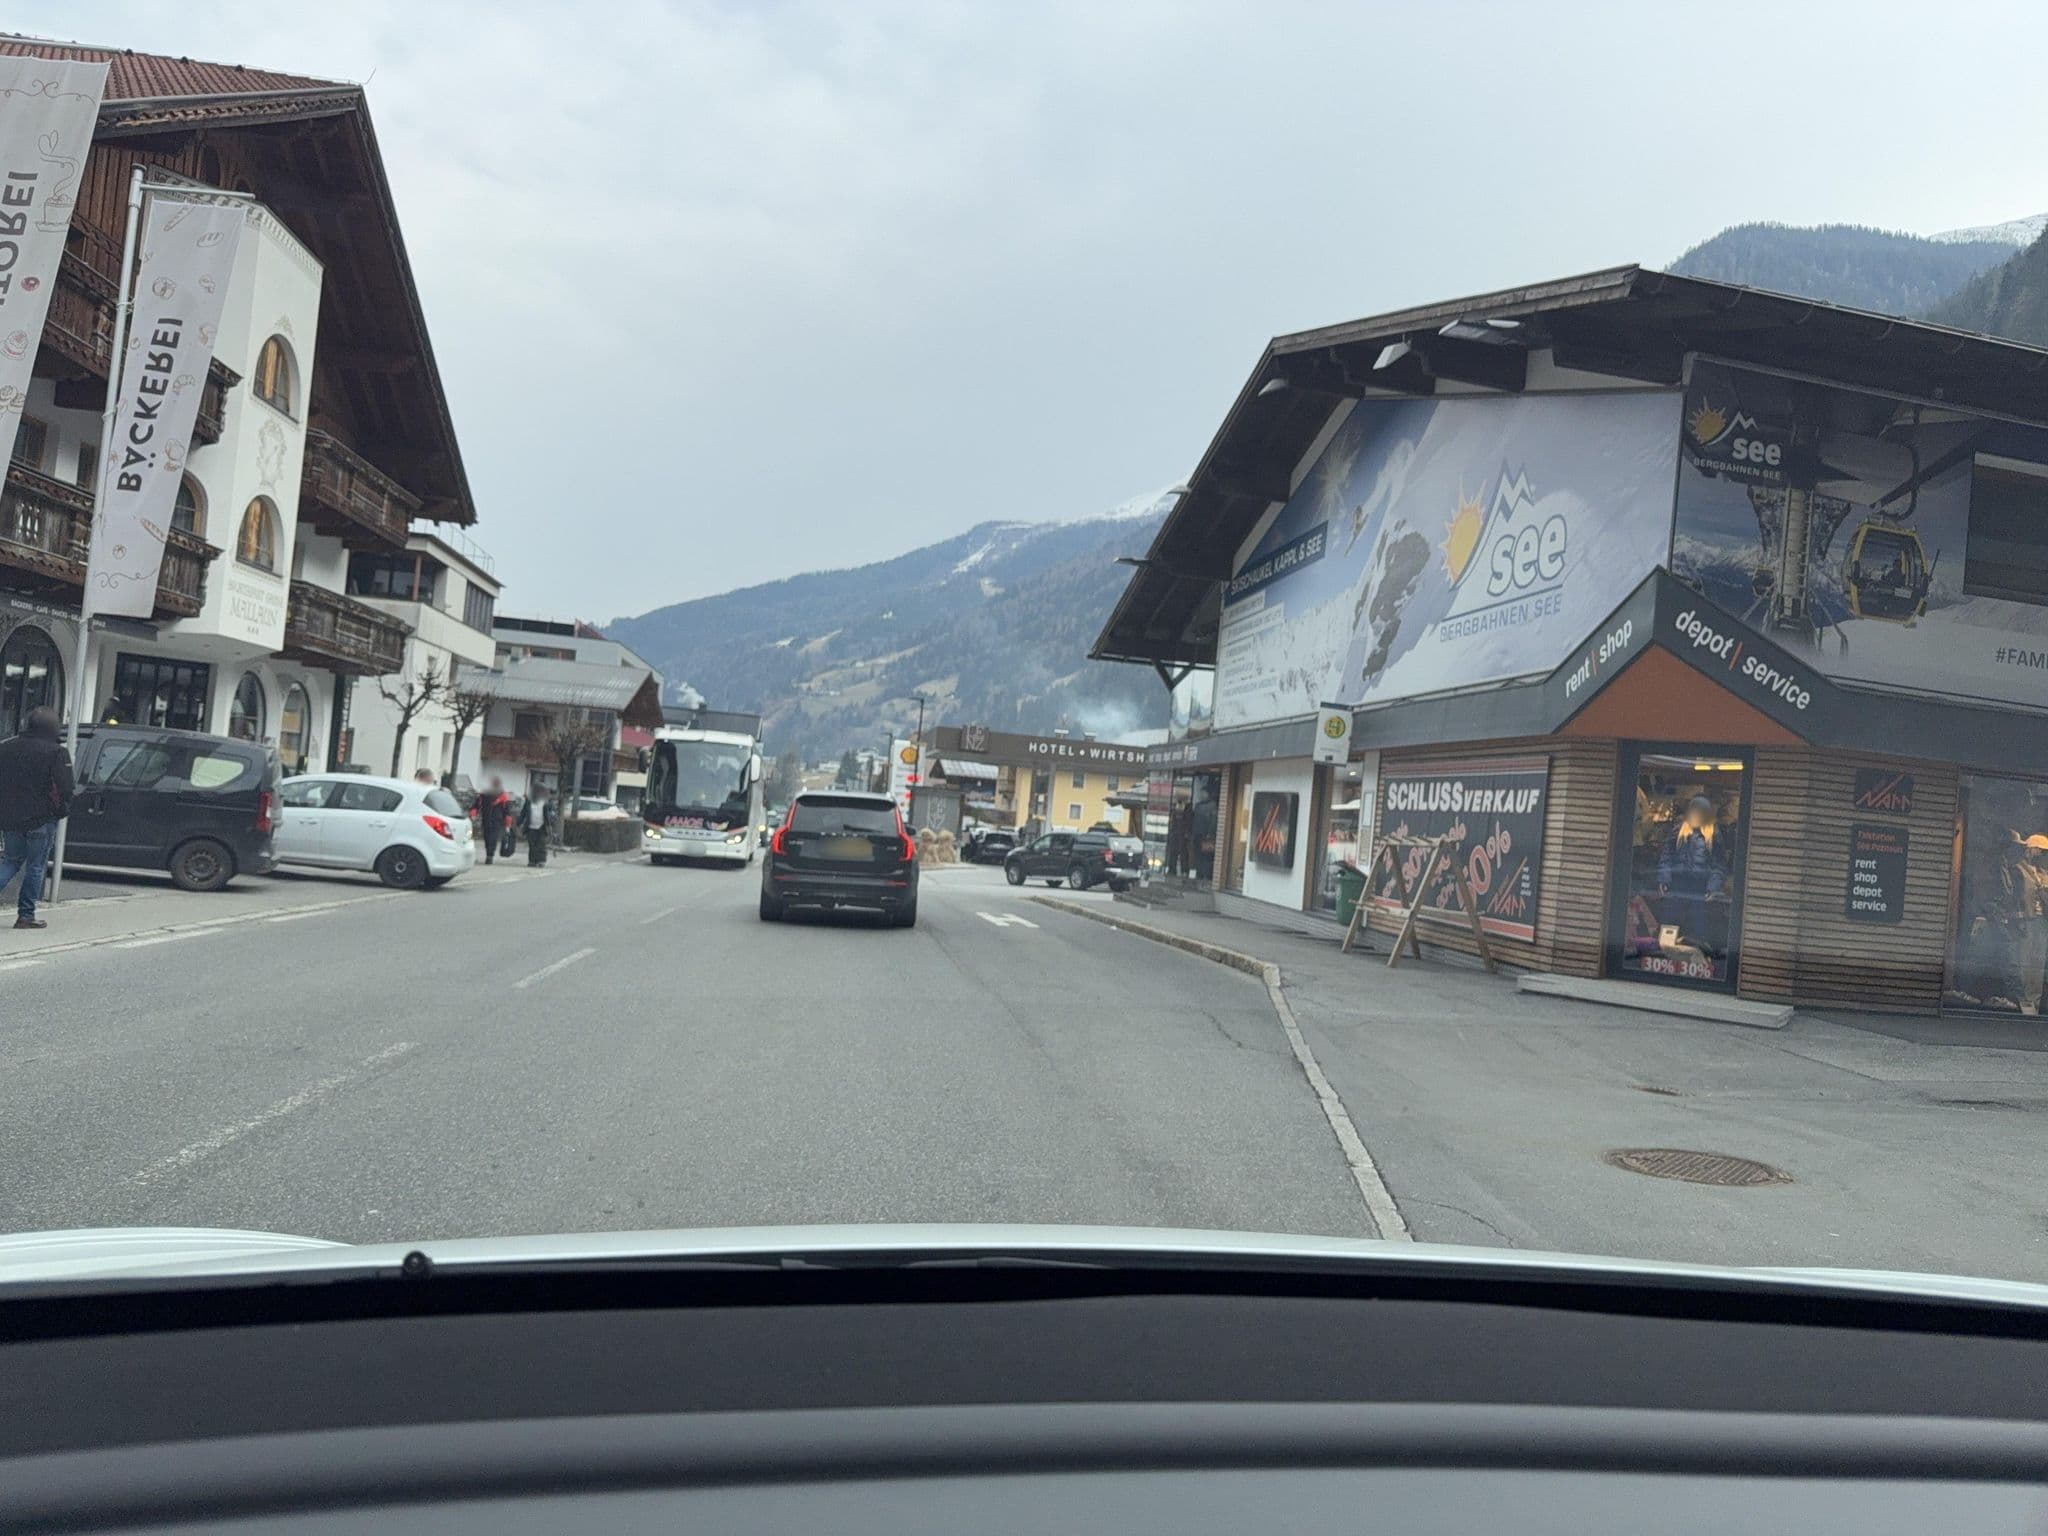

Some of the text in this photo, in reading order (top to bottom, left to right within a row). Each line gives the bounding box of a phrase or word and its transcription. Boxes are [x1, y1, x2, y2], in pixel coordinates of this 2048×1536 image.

[1732, 437, 1782, 466] see
[1694, 457, 1781, 480] BERGBAHNEN SEE
[1274, 547, 1297, 574] KAPPL
[1306, 533, 1323, 556] SEE
[1487, 514, 1567, 596] see
[1439, 589, 1563, 642] BERGBAHNEN SEE
[1565, 618, 1633, 699] rent shop
[1674, 608, 1811, 712] depot service
[1029, 742, 1075, 756] HOTEL
[1090, 748, 1145, 763] WIRTSH
[1387, 781, 1541, 814] SCHLUSSVERKAUF
[1855, 858, 1877, 870] rent
[1854, 872, 1877, 884] shop
[1853, 885, 1882, 898] depot
[1852, 900, 1887, 912] service
[1679, 960, 1711, 979] 30%
